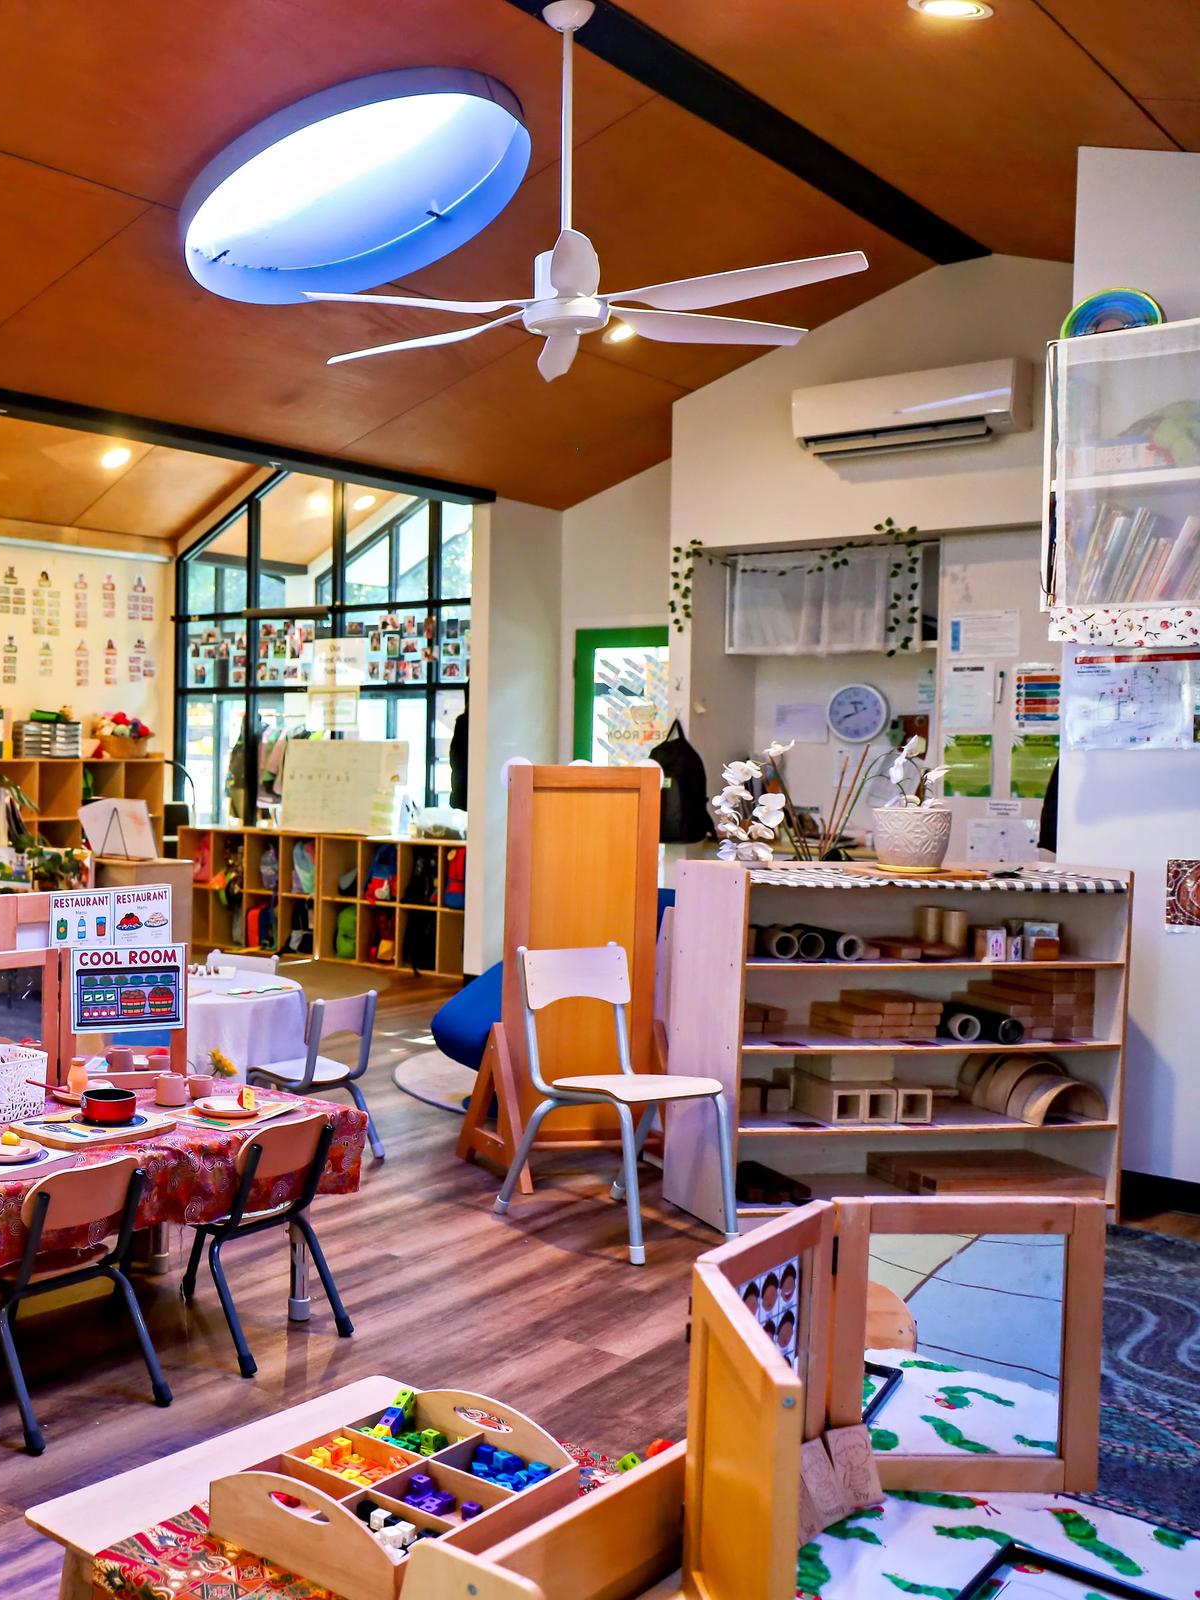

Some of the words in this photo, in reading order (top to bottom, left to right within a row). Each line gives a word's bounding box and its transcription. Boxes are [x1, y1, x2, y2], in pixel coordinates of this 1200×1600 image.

[53, 895, 109, 909] RESTAURANT
[116, 890, 168, 905] RESTAURANT
[79, 951, 123, 967] COOL
[128, 949, 177, 965] ROOM
